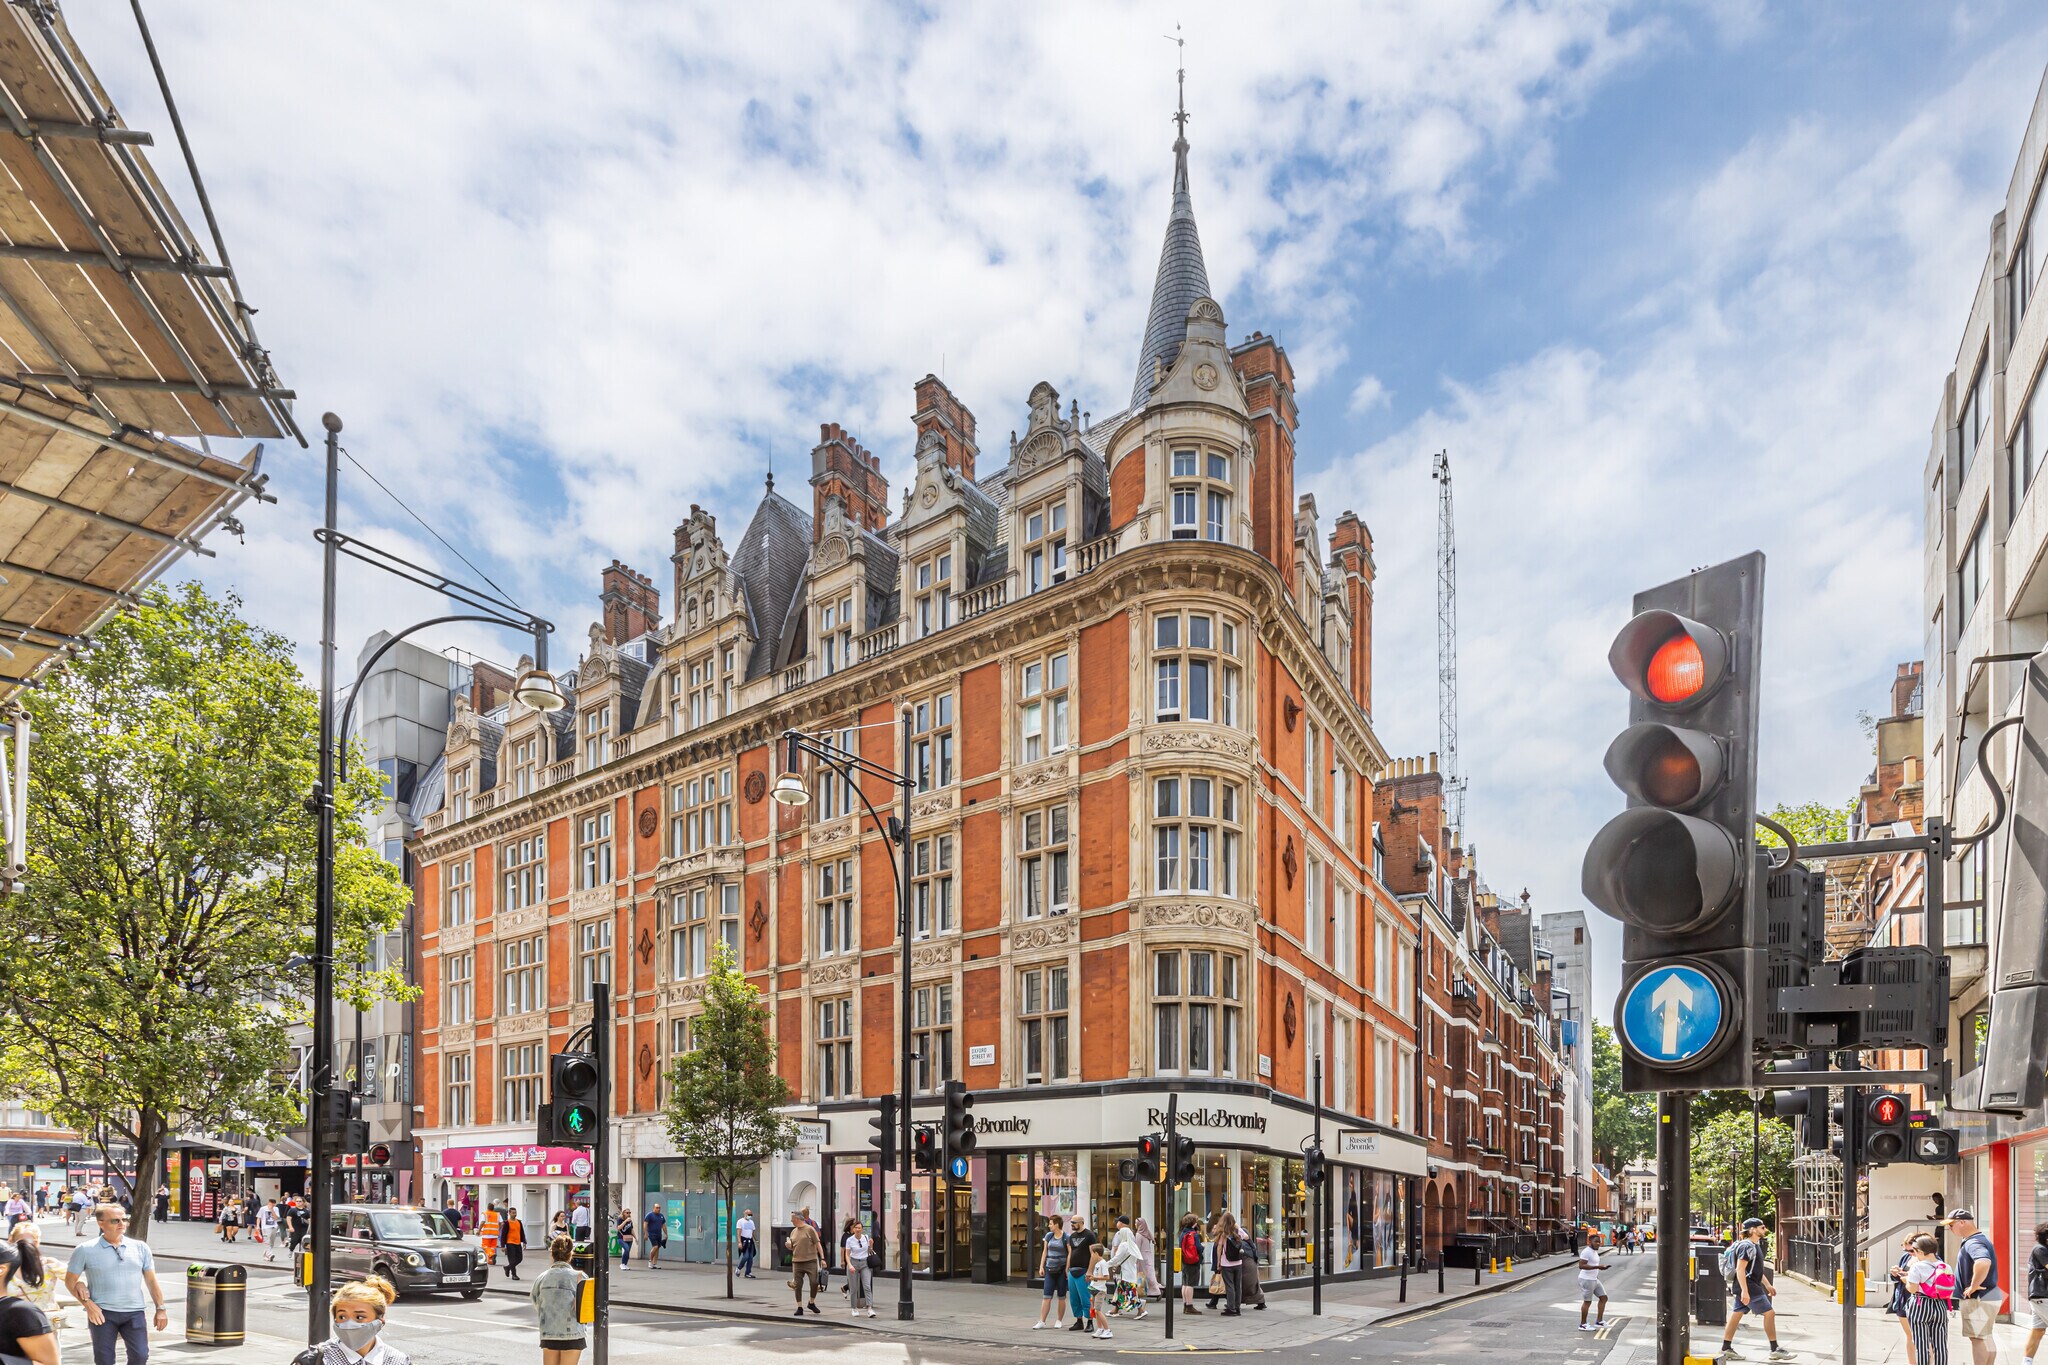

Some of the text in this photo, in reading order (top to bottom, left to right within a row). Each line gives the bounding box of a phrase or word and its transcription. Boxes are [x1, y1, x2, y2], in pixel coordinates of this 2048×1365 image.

[386, 1063, 401, 1078] JD
[802, 1125, 822, 1134] Russell
[1349, 1136, 1373, 1144] Russell
[189, 1176, 203, 1186] SALE
